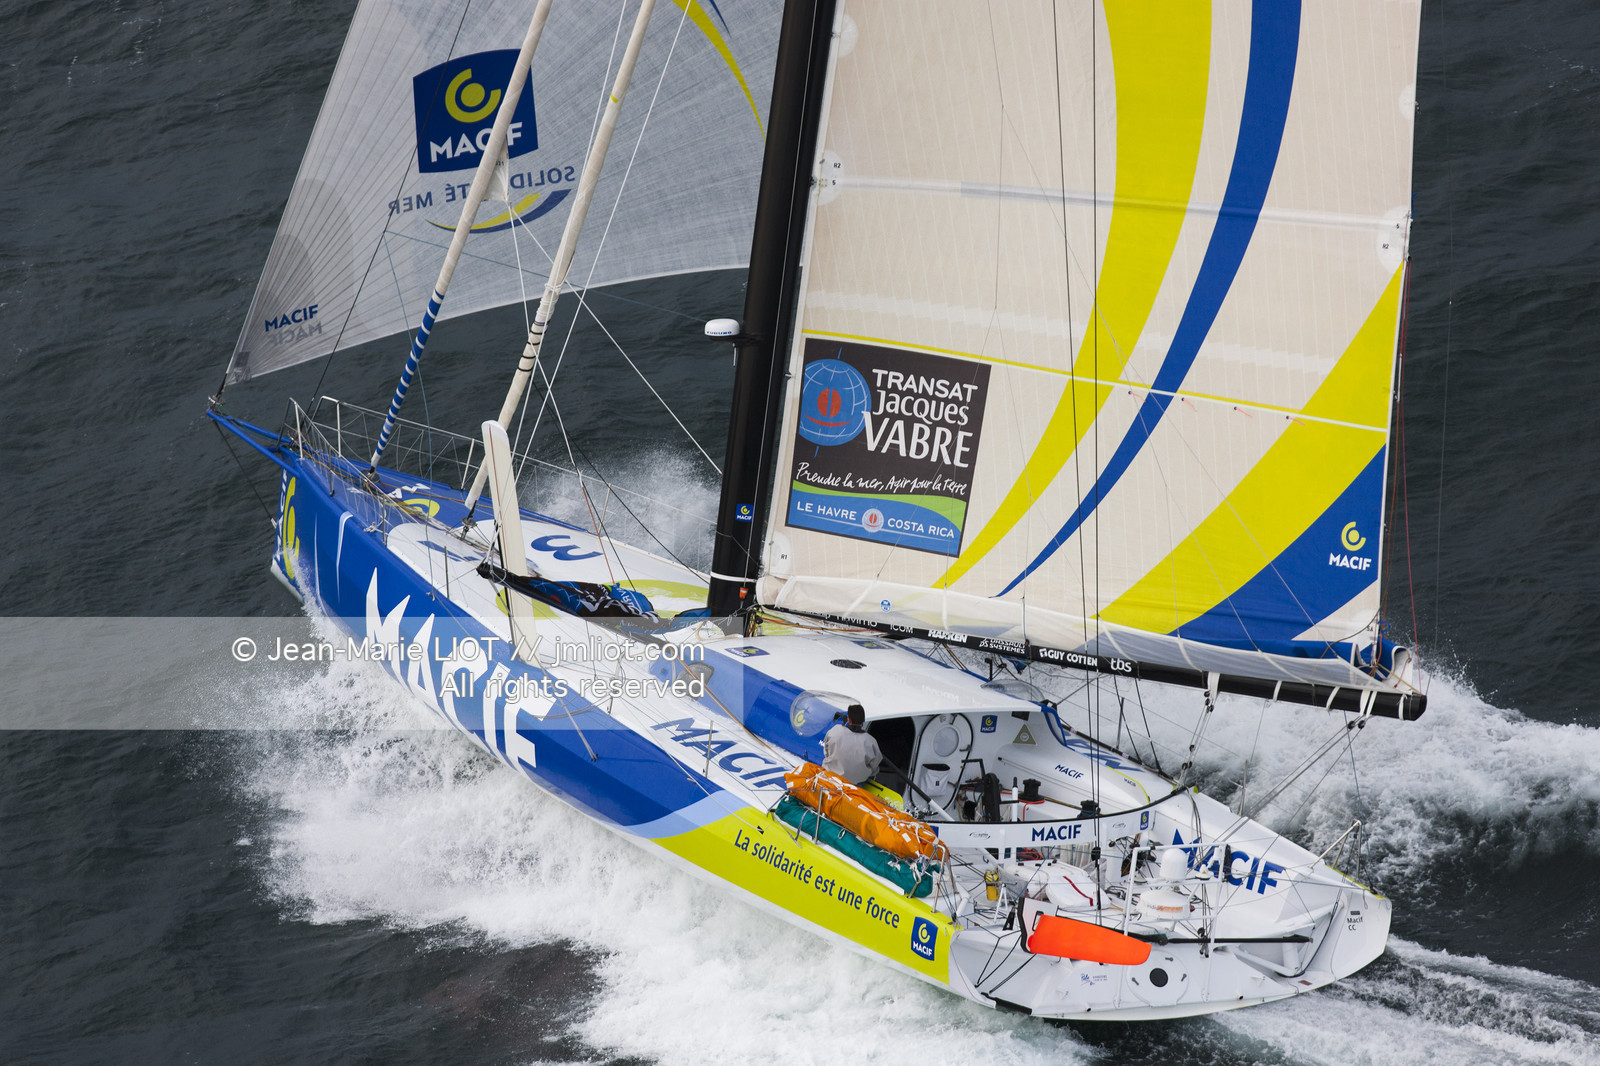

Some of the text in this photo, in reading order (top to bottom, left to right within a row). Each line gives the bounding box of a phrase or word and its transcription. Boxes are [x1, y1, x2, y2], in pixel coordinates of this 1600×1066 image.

[429, 121, 523, 163] MACF
[264, 304, 319, 332] MACIF
[872, 368, 978, 403] TRANSAT
[861, 410, 974, 468] VABRE
[796, 462, 841, 487] Prendre
[842, 472, 855, 488] la
[856, 477, 884, 492] mer,
[908, 477, 933, 493] pour
[932, 473, 943, 491] la
[796, 501, 857, 521] LE HAVRE
[887, 517, 955, 539] COSTA RICA
[1328, 552, 1372, 571] MACIF
[928, 630, 968, 644] HARKEN
[1047, 649, 1064, 662] GUY
[1110, 657, 1133, 673] tbs
[1055, 764, 1084, 779] MACIF
[1031, 823, 1082, 842] MACIF
[734, 829, 900, 929] La solidarité est une force
[912, 940, 933, 957] MACIF
